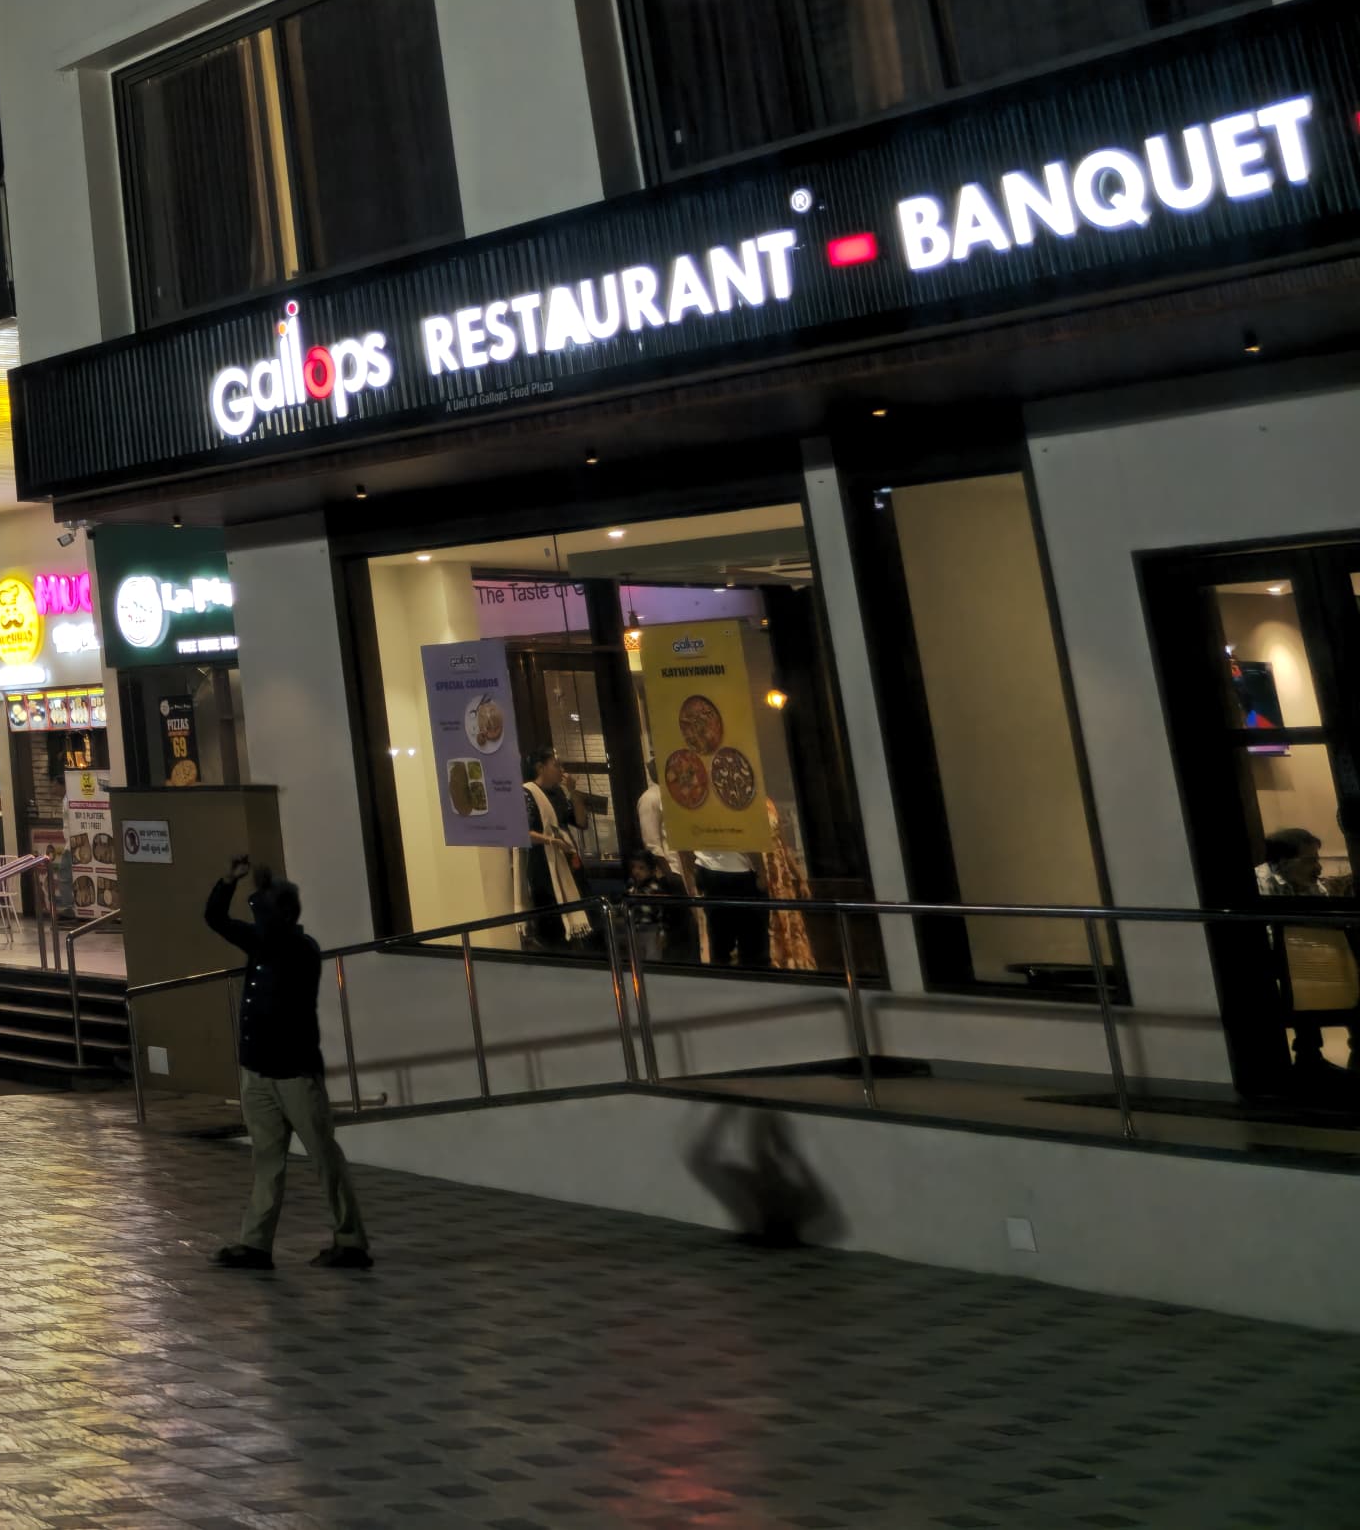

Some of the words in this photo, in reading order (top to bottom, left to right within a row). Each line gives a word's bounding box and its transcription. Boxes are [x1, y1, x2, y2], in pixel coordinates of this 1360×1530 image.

[424, 229, 797, 377] RESTAURANT
[899, 96, 1312, 271] BANQUET
[453, 396, 468, 411] Unit
[479, 390, 508, 406] Gallops
[510, 384, 529, 399] Food
[531, 381, 554, 395] Plaza
[475, 586, 505, 605] The
[508, 582, 549, 602] Taste
[661, 664, 725, 678] KATHIYAWADI
[435, 680, 465, 691] SPECIAL
[466, 677, 499, 689] COMBOS
[167, 718, 190, 731] PIZZAS
